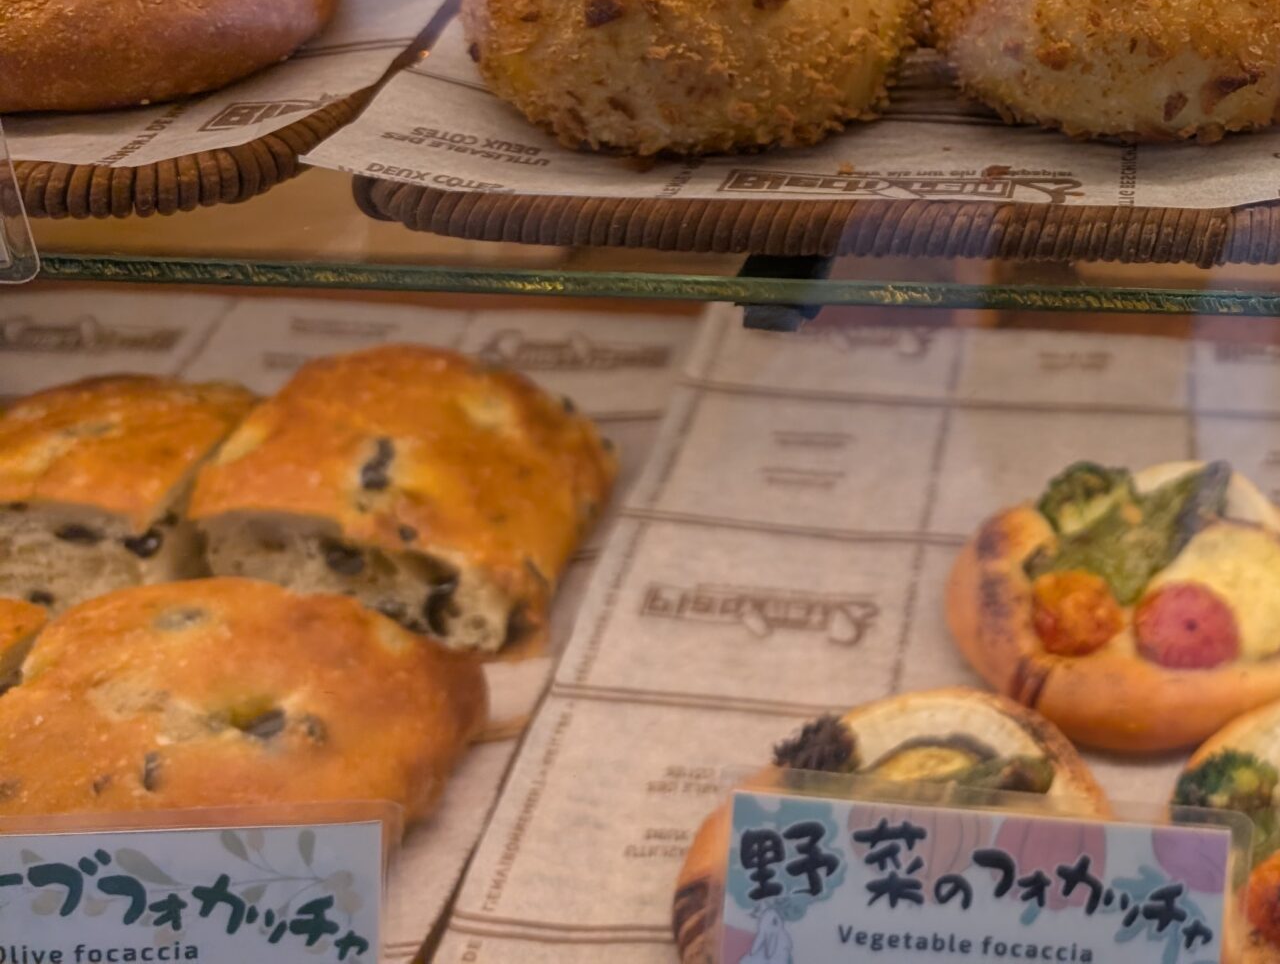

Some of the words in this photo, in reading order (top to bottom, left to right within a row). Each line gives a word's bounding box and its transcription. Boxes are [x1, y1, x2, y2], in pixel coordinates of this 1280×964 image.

[481, 138, 542, 156] DEUX
[740, 818, 1215, 950] 野菜のフォカッチャ
[73, 942, 199, 963] focaccia
[837, 923, 972, 956] Vegetable
[982, 939, 1094, 964] focaccia
